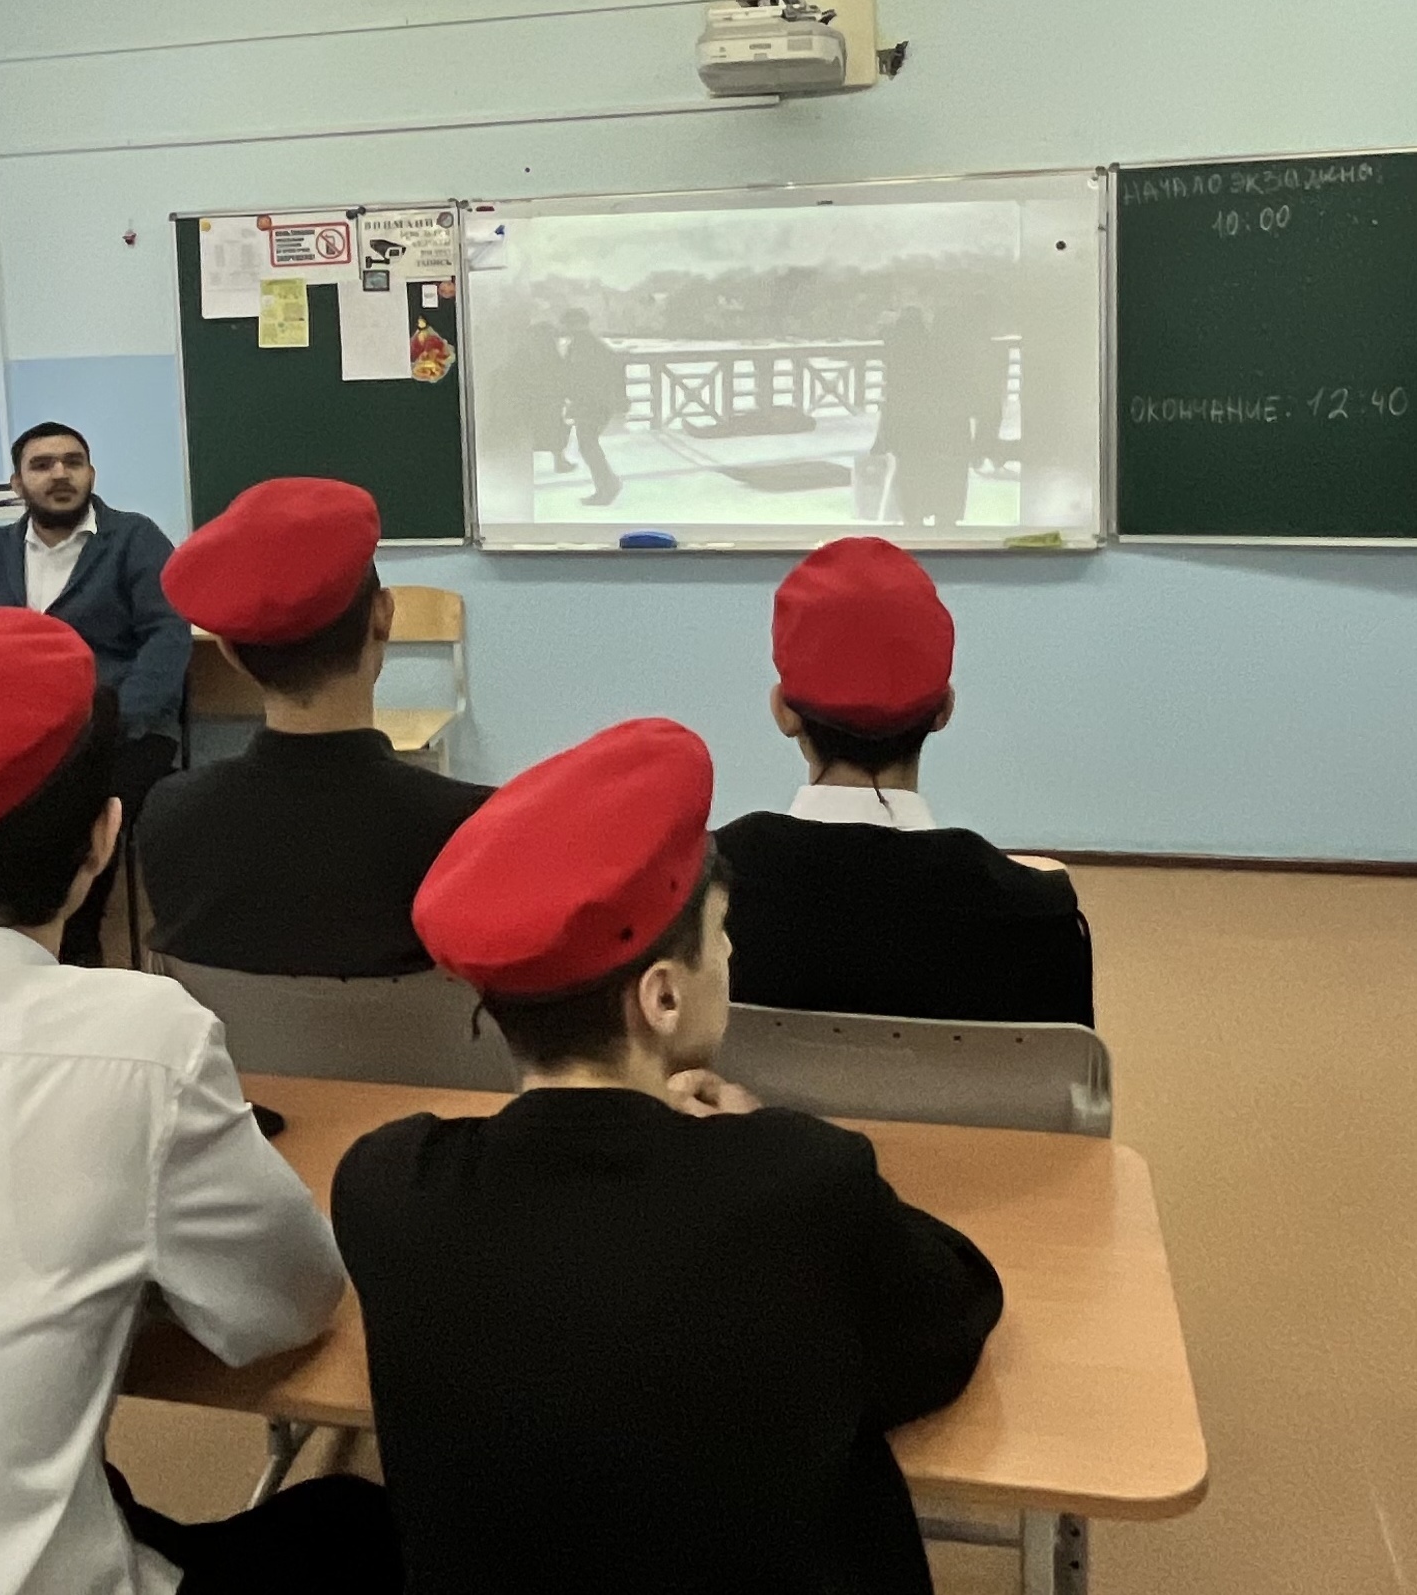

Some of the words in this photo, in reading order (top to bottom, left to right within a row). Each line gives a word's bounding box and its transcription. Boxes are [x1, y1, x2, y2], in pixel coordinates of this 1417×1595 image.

[1123, 173, 1222, 206] НАЧАЛО
[1212, 204, 1291, 237] 10:00
[1306, 386, 1409, 420] 12:40
